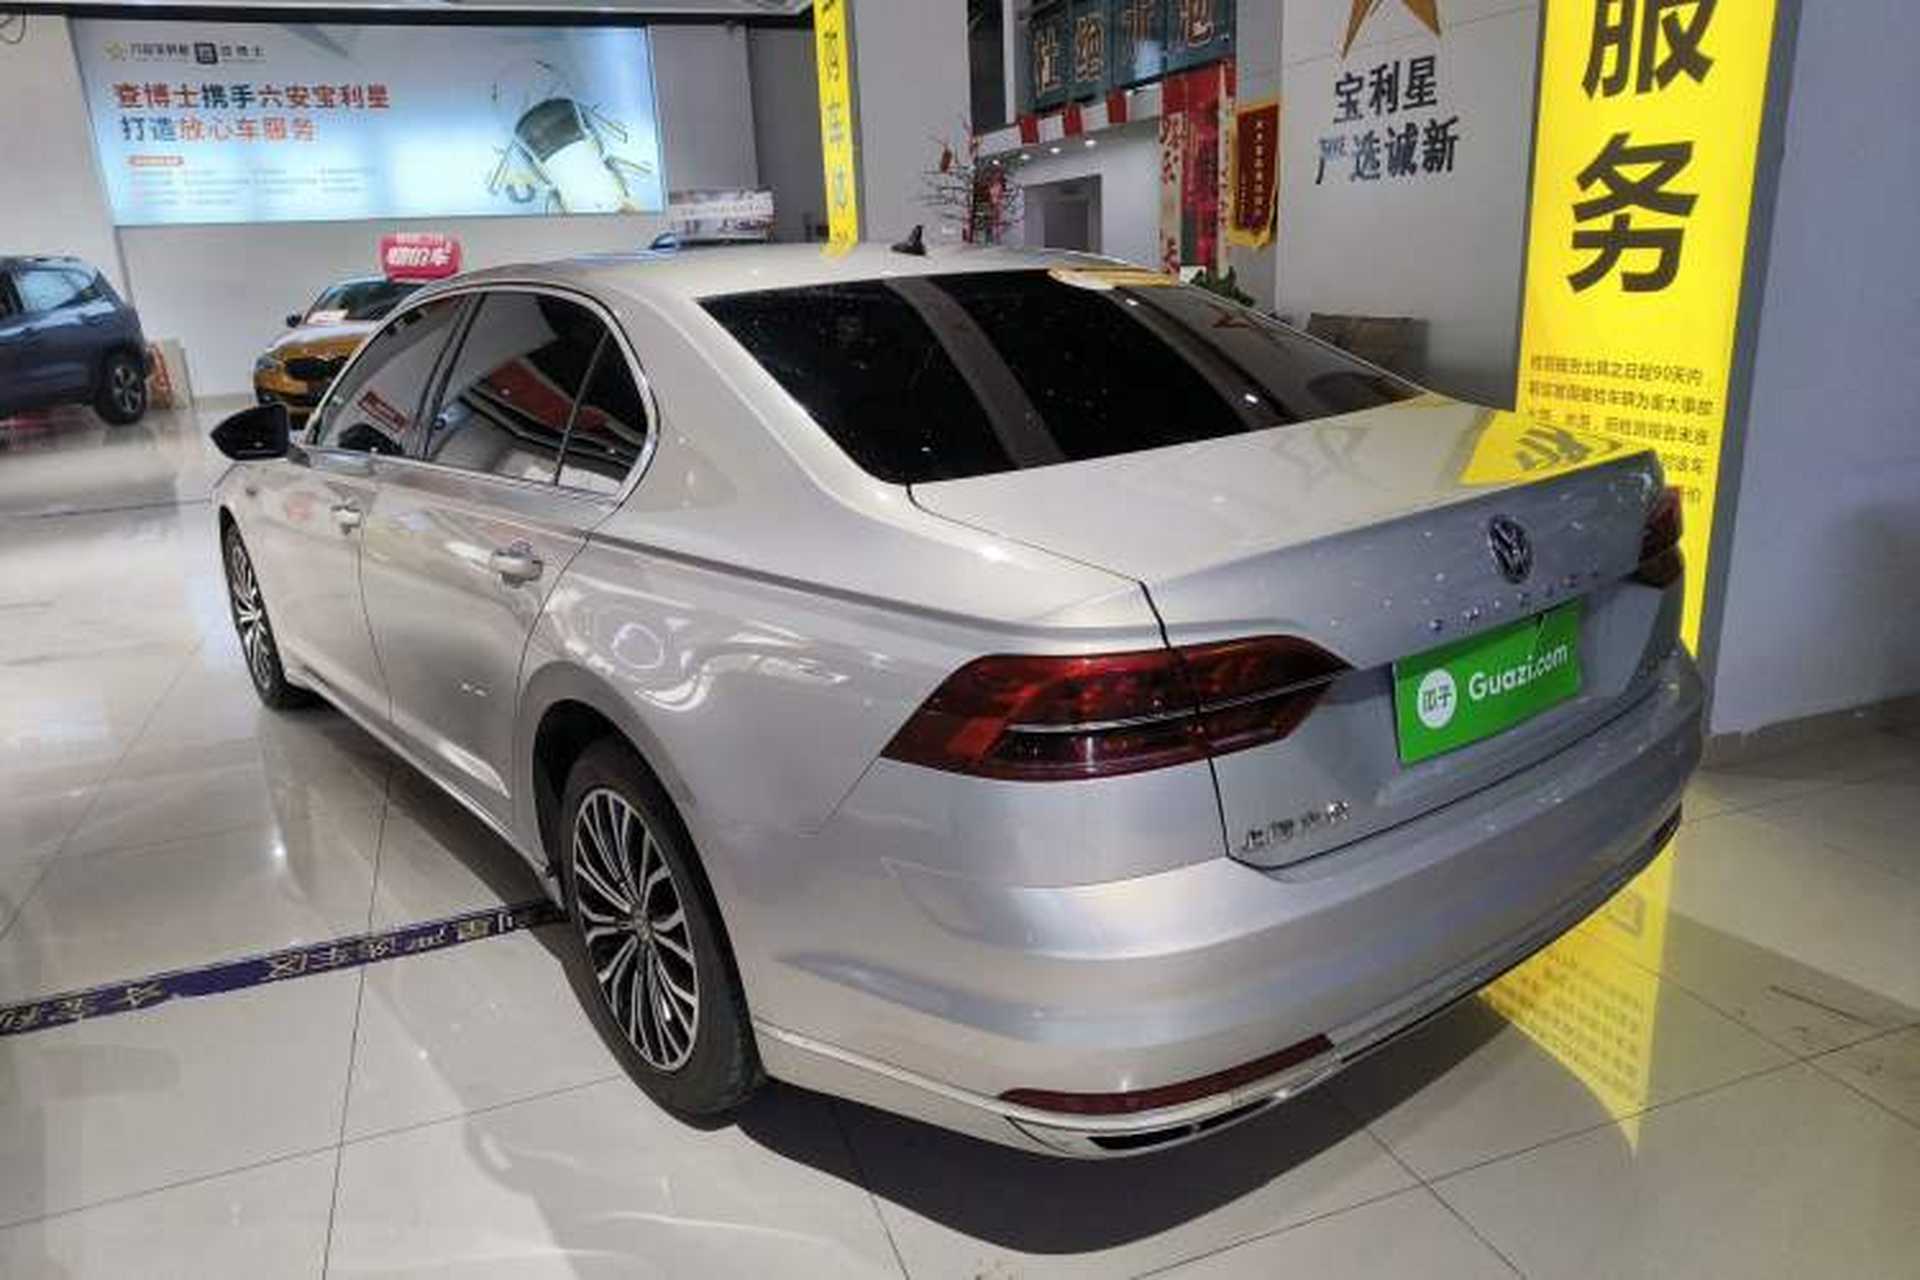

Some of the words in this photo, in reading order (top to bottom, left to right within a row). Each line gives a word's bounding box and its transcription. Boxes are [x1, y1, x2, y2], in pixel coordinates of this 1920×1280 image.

[115, 83, 390, 110] 查博士携手六安宝利星
[1333, 55, 1438, 125] 宝利星
[121, 116, 317, 142] 打造放心车服务
[1567, 0, 1718, 294] 服务
[1468, 643, 1569, 701] Guazi.com
